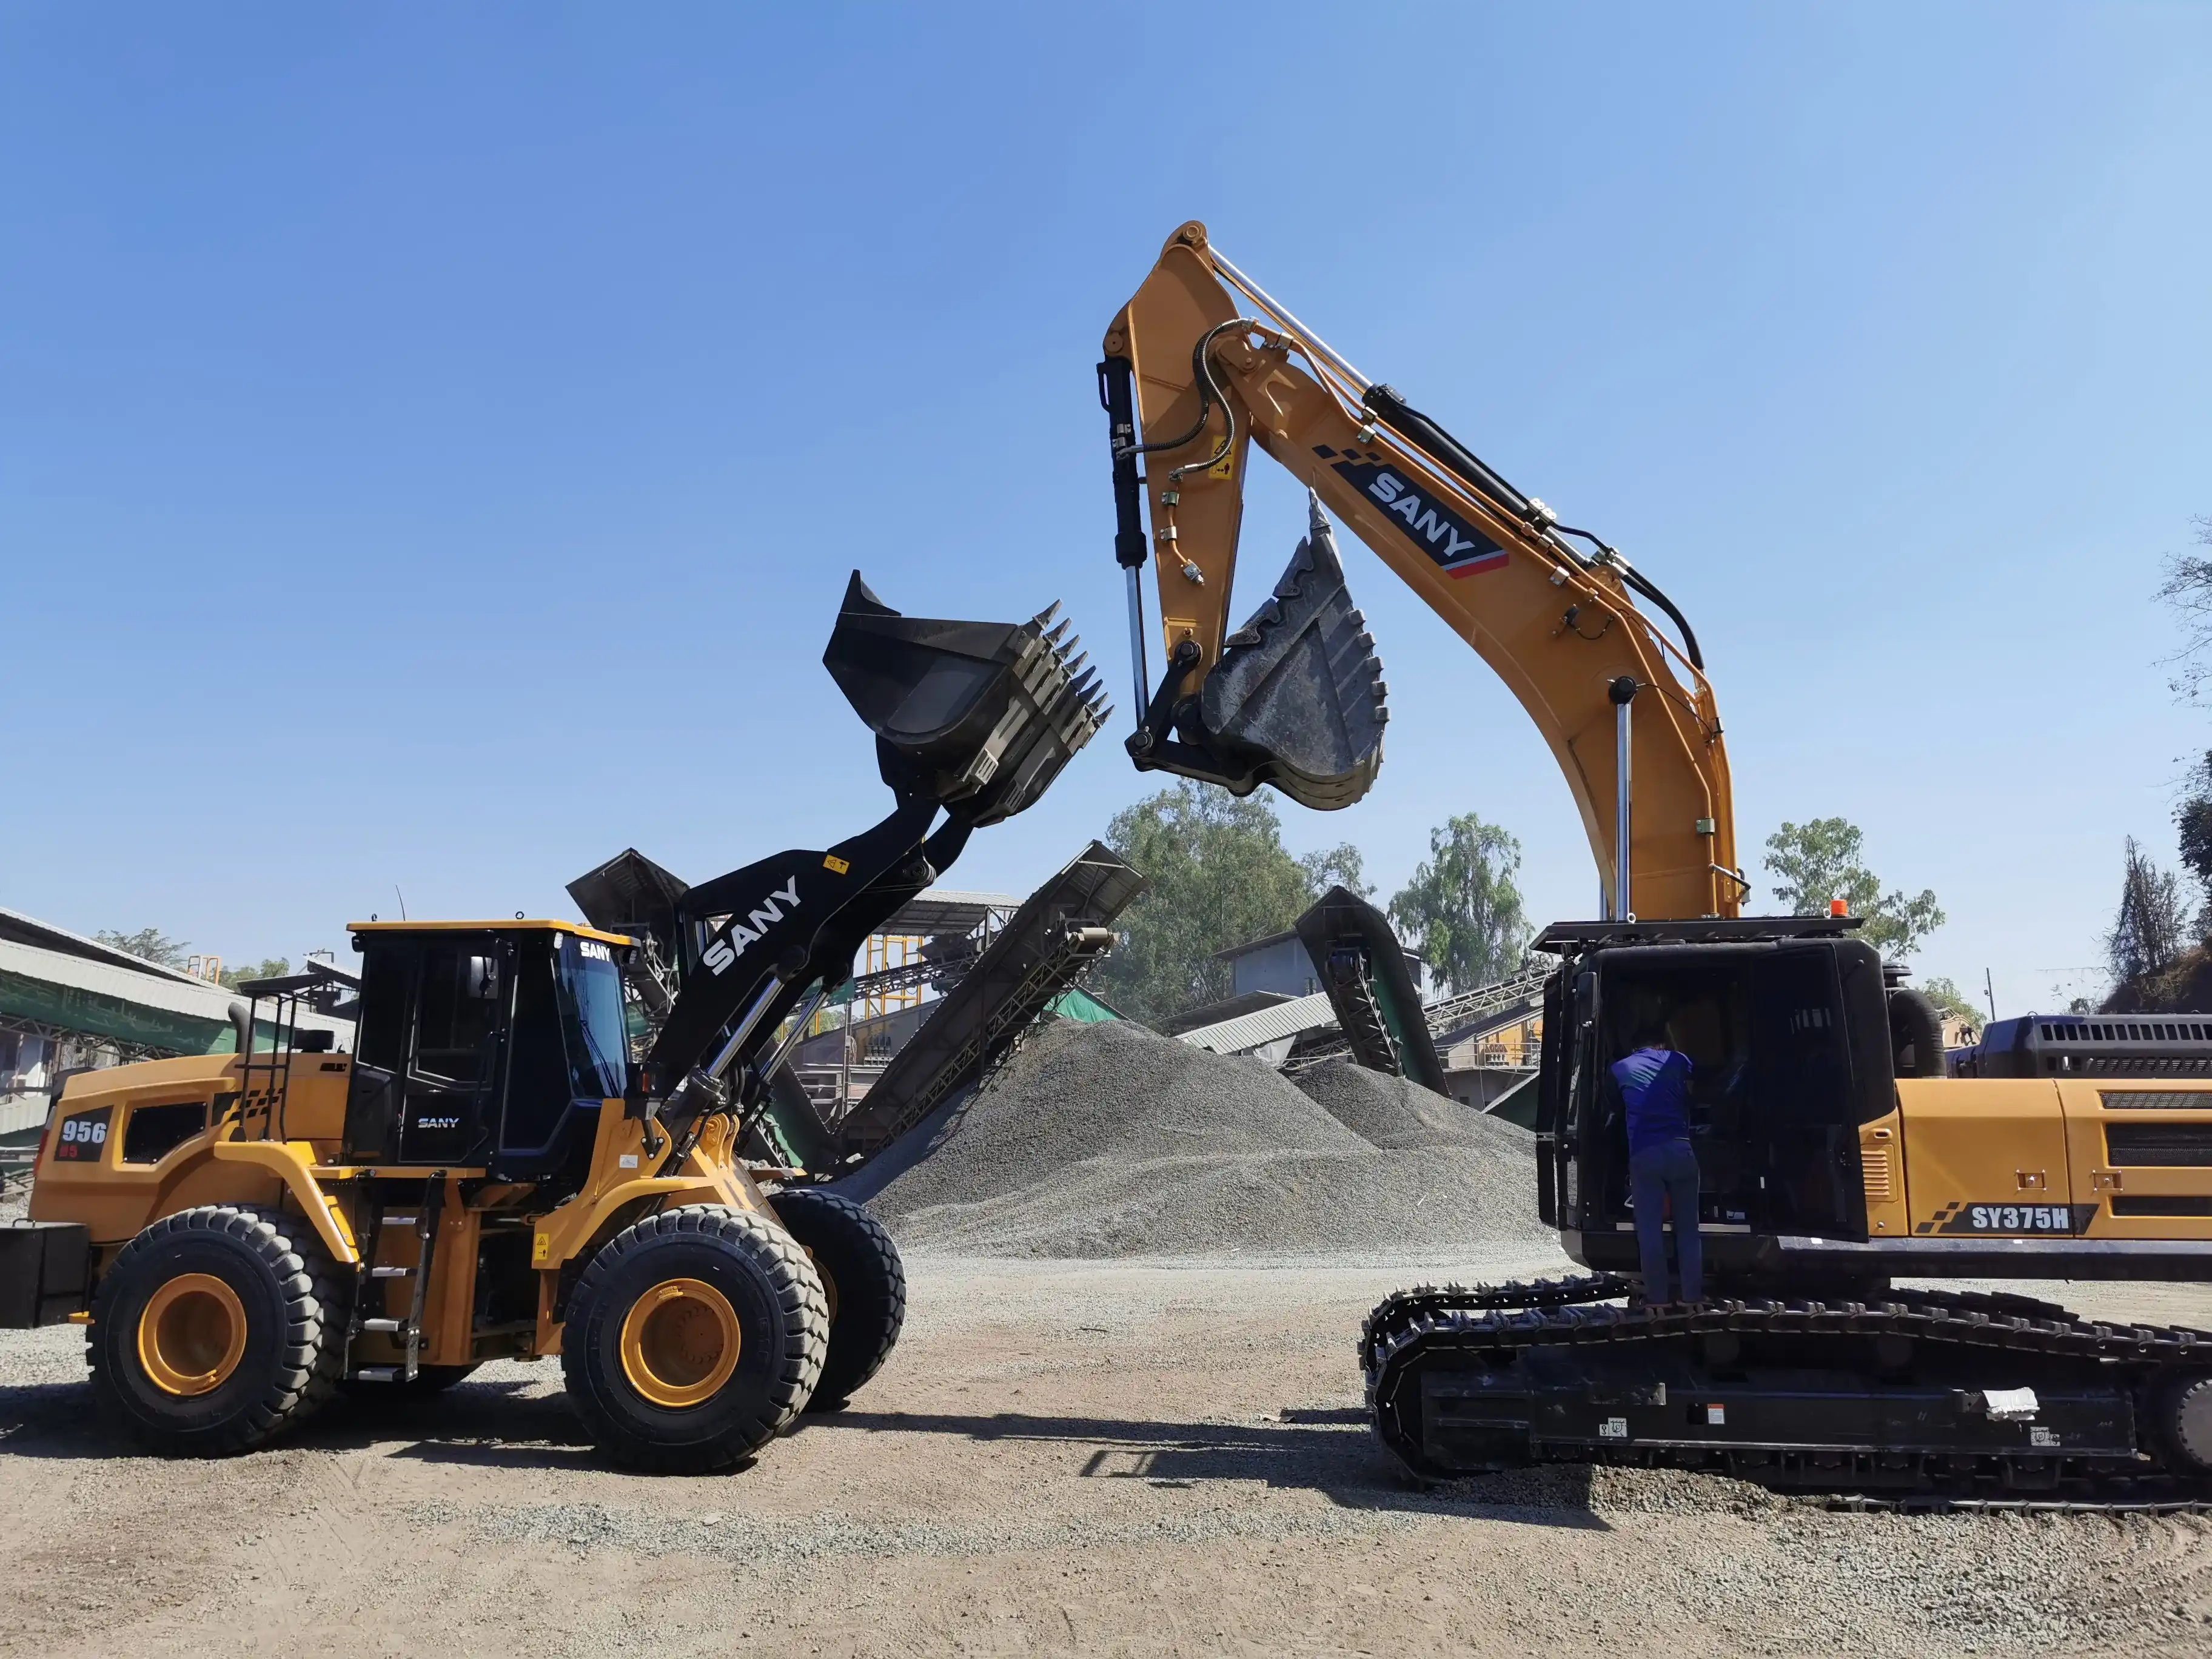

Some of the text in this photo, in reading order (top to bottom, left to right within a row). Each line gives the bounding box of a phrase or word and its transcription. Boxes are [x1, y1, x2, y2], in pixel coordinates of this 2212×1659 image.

[1368, 472, 1475, 558] SANY
[703, 874, 802, 976] SANY
[580, 941, 611, 962] SANY
[62, 1120, 107, 1144] 956
[418, 1117, 460, 1129] SANY
[1971, 1207, 2069, 1229] SY375H
